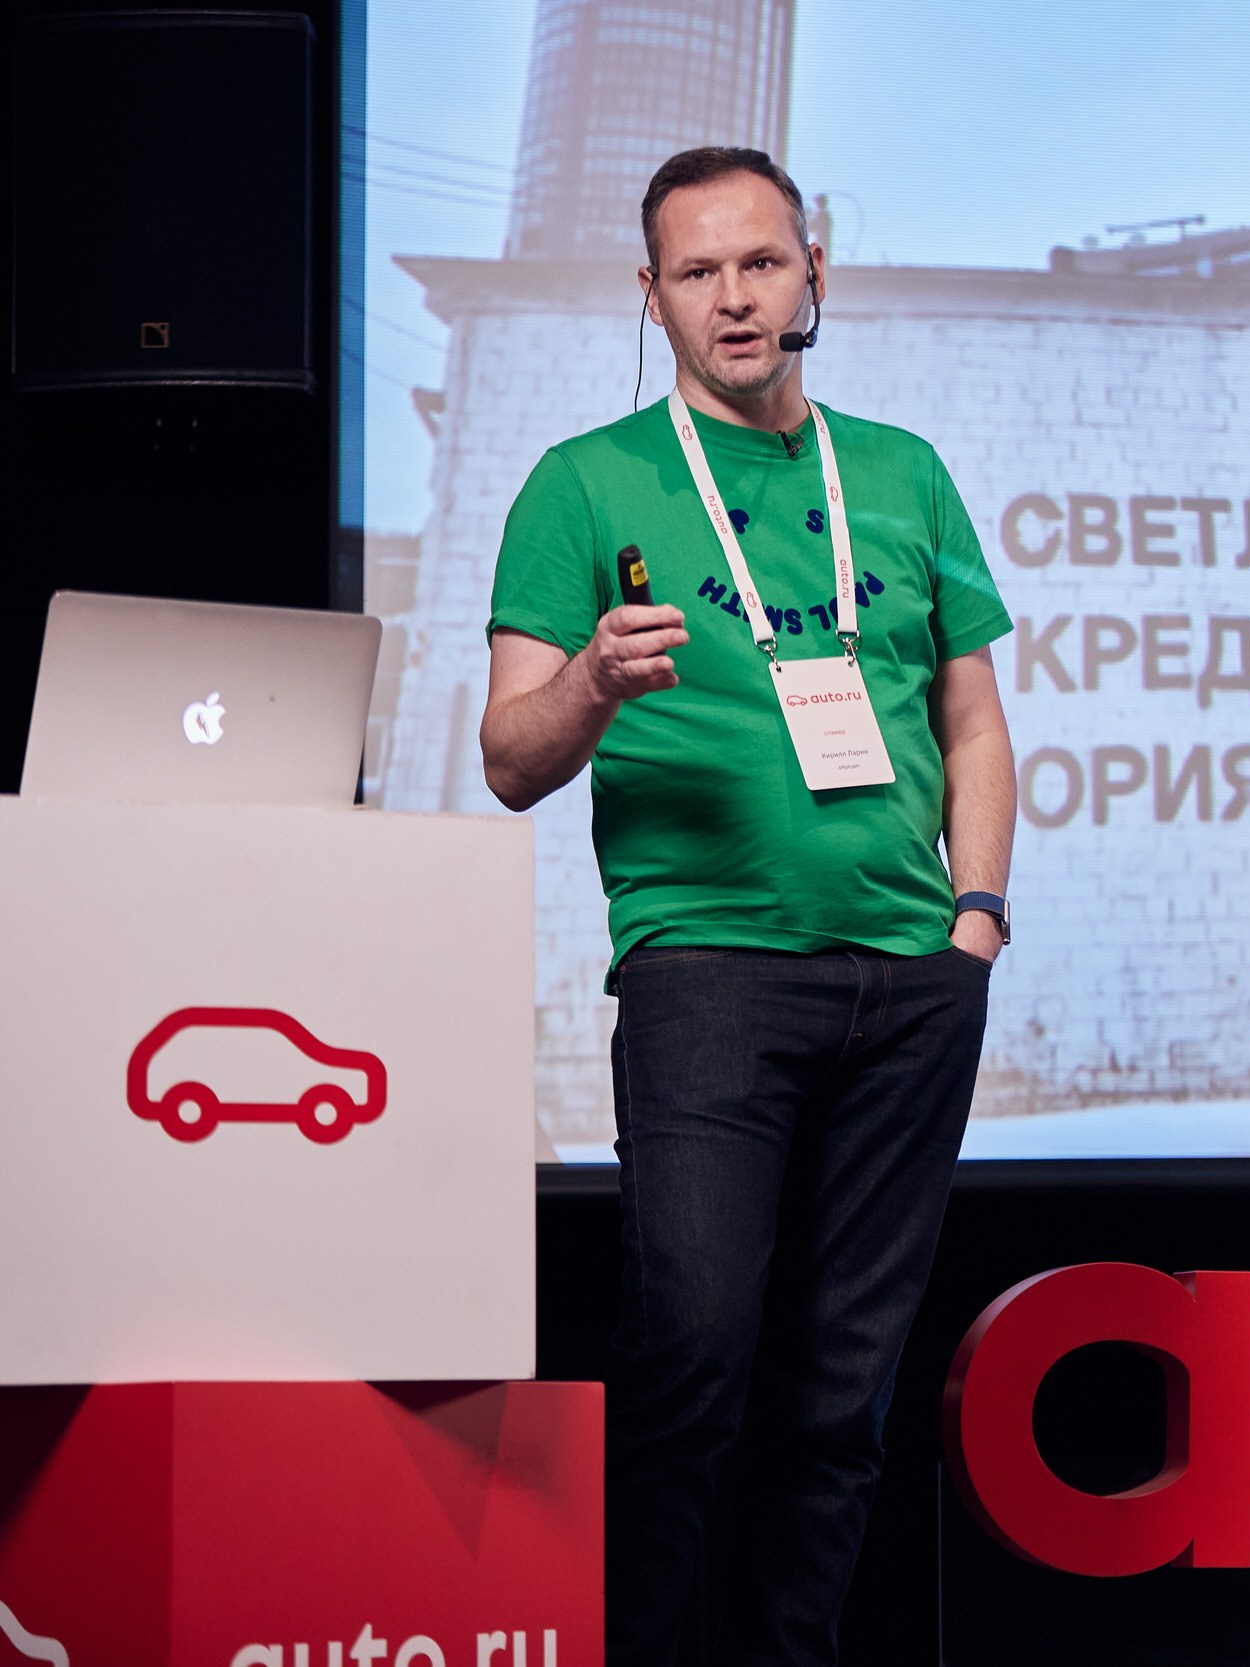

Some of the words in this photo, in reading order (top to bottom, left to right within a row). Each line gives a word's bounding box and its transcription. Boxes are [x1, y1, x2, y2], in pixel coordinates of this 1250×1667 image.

[707, 495, 728, 535] auto.ru
[840, 559, 850, 599] auto.ru
[810, 691, 862, 704] auto.ru
